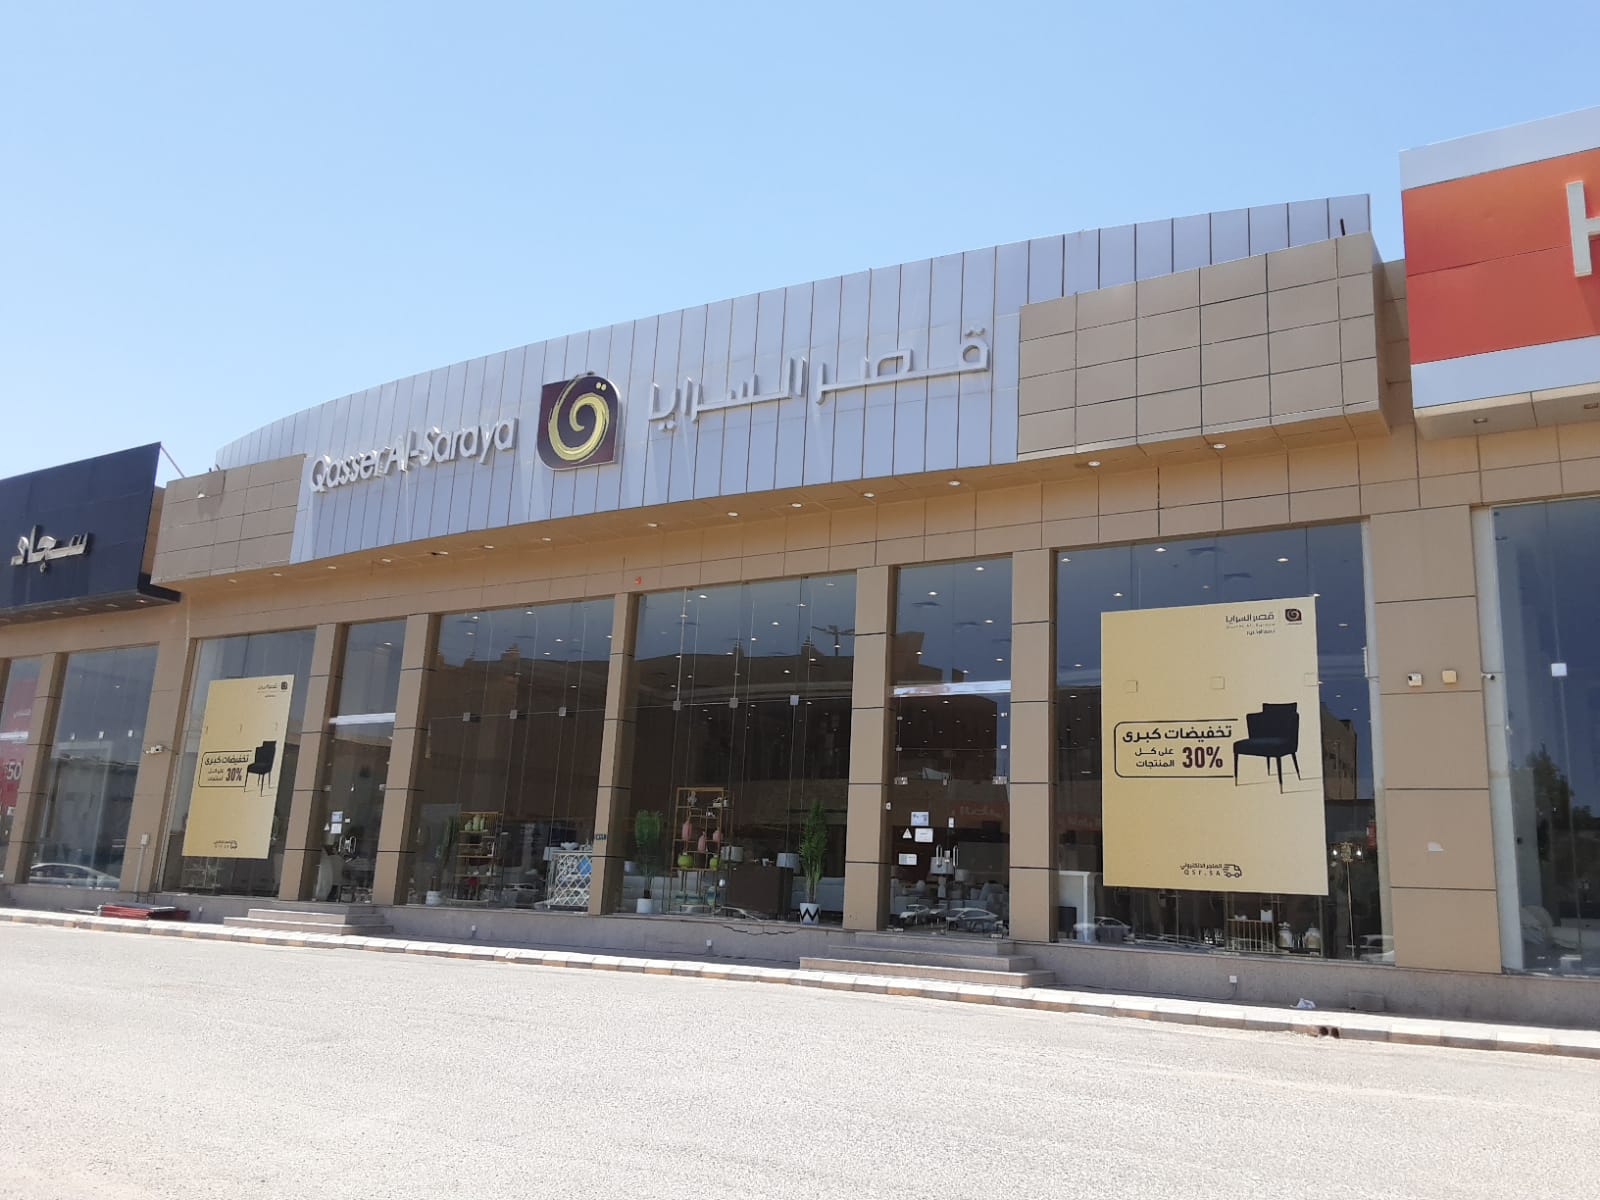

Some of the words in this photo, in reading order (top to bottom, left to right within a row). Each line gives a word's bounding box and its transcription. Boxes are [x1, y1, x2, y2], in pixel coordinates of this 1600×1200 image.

[816, 327, 990, 405] قصر
[648, 356, 806, 432] السرايا
[311, 449, 386, 493] Qasser
[384, 417, 518, 472] Al-Saraya
[1122, 728, 1161, 744] كبرى
[1164, 725, 1232, 743] تخفيضات
[1158, 747, 1175, 757] على
[1182, 746, 1224, 769] 30%
[1135, 759, 1175, 770] المنتجات
[225, 767, 243, 782] 30%
